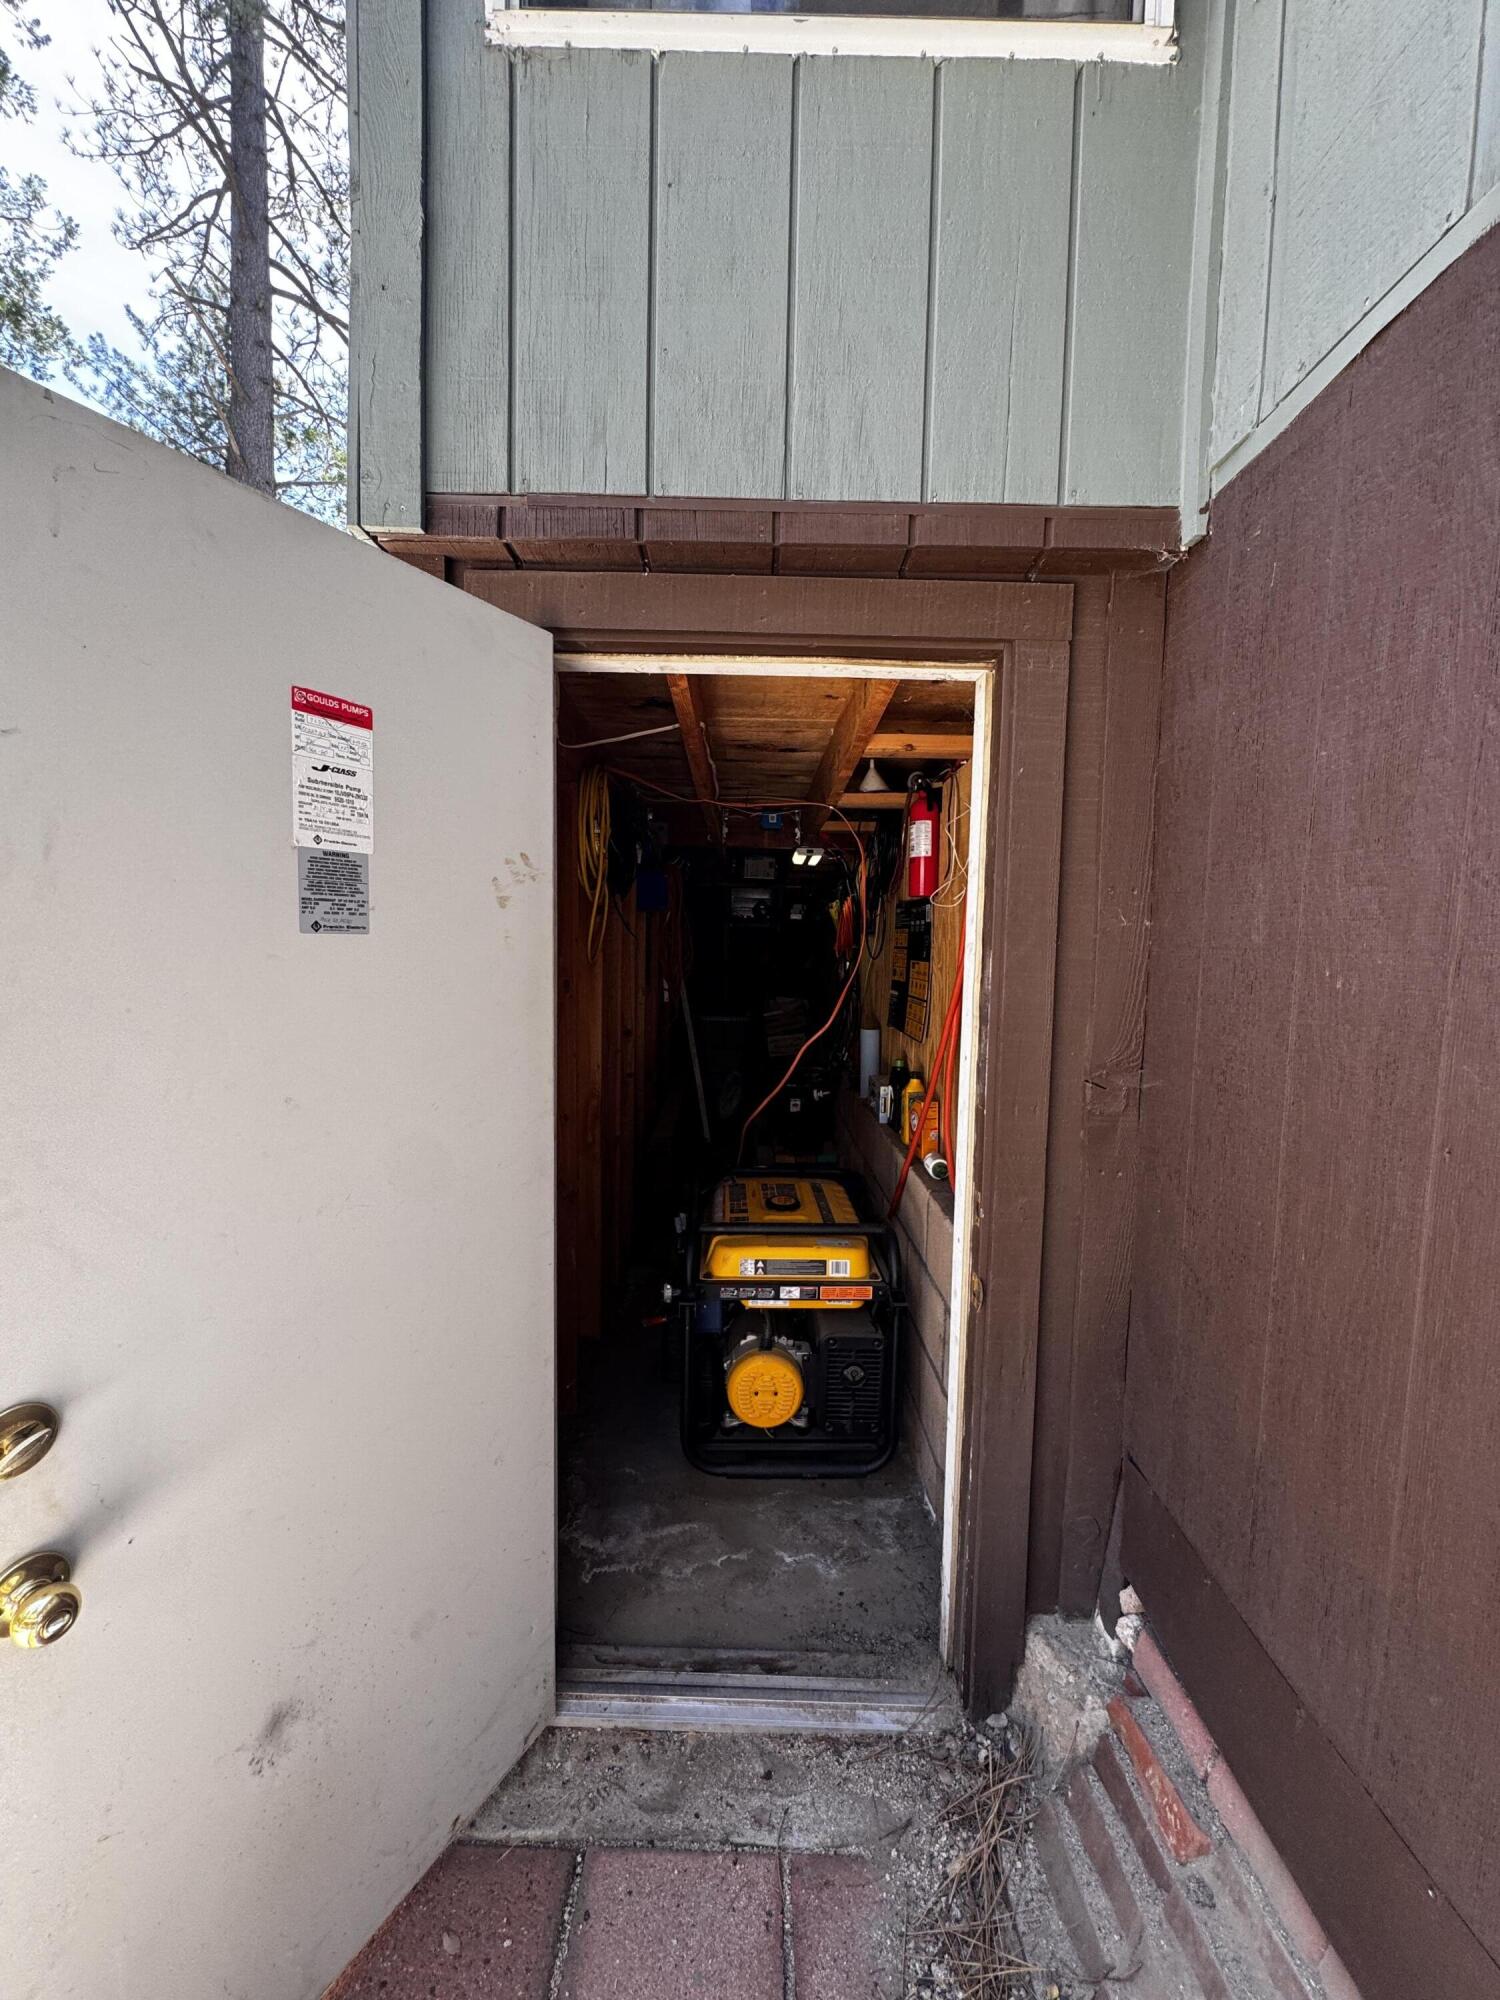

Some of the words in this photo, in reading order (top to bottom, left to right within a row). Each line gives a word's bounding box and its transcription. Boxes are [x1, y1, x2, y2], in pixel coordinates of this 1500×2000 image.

[307, 693, 339, 709] GOULDS
[341, 703, 369, 717] PUMPS
[307, 777, 344, 790] Submersible
[345, 784, 362, 794] Pump
[322, 850, 350, 859] WARNING
